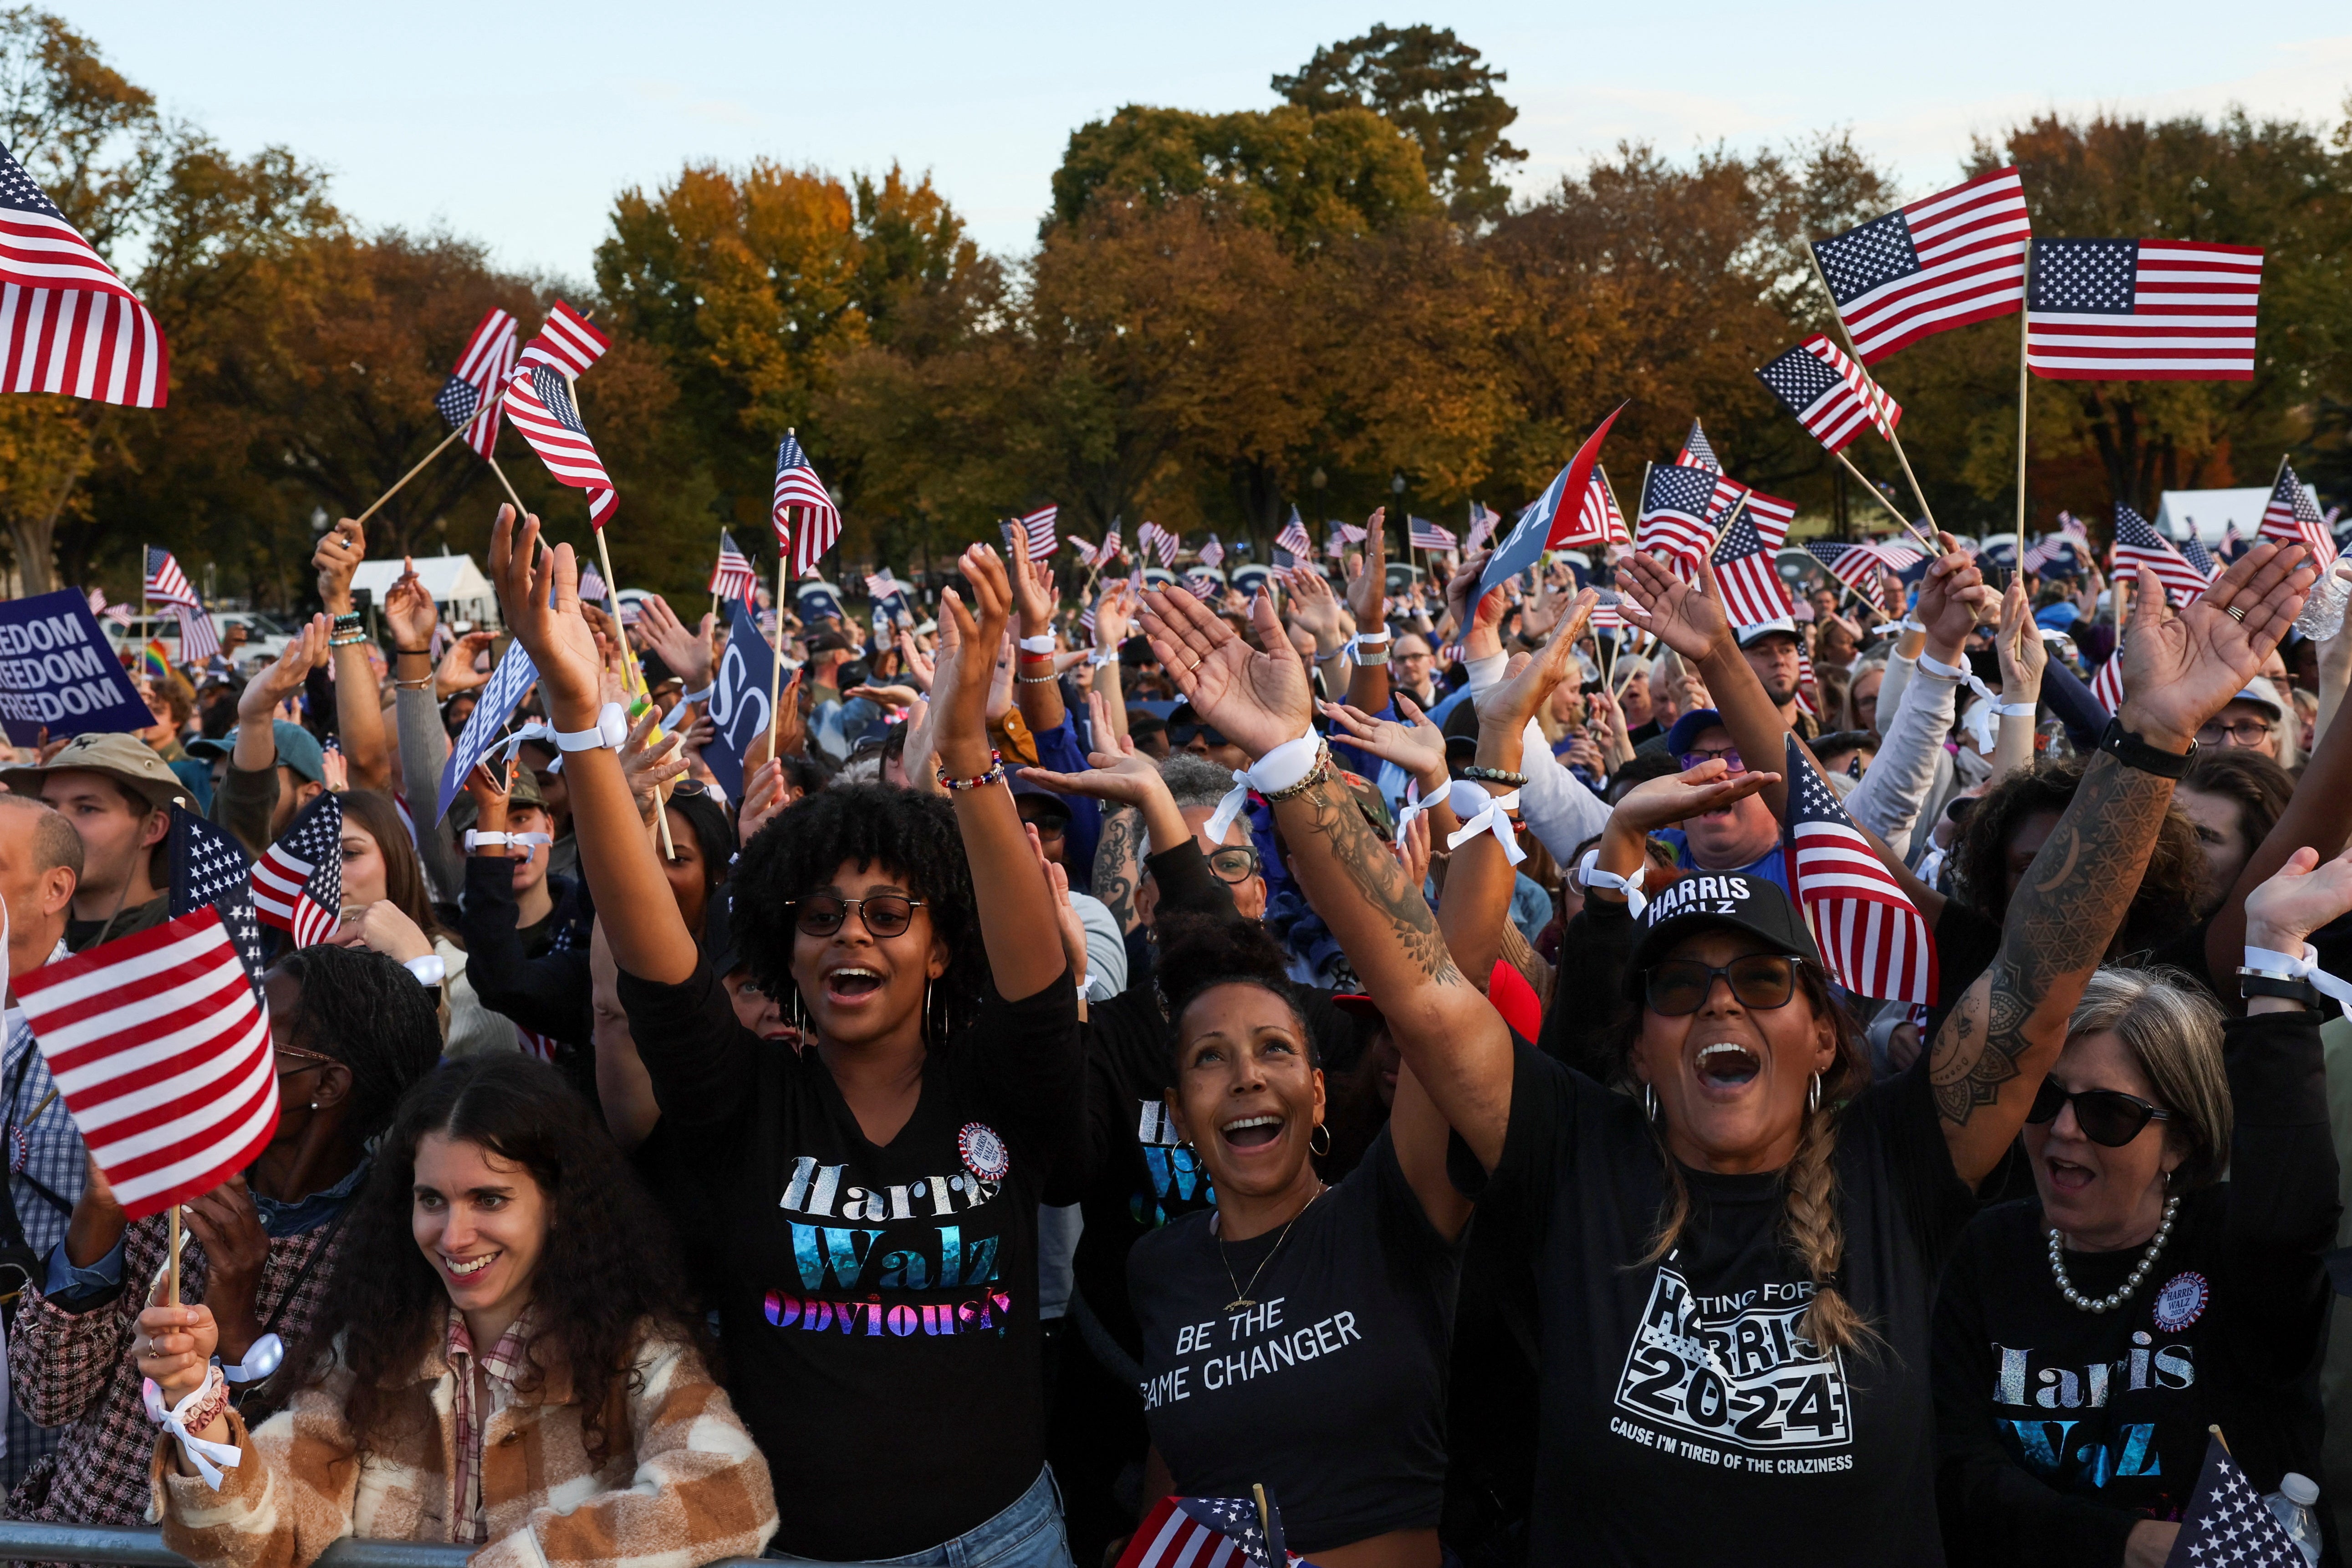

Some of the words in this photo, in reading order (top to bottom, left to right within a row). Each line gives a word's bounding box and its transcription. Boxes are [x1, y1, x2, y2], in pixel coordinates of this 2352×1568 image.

[0, 613, 88, 656] EDOM
[0, 677, 126, 723] FREEDOM
[709, 624, 770, 768] US
[1648, 876, 1750, 929] HARRIS
[973, 1134, 987, 1158] HARRIS
[982, 1141, 995, 1161] WALZ
[991, 1150, 999, 1164] 2024
[786, 1220, 999, 1290] Walz
[1764, 1281, 1817, 1301] FOR
[2167, 1287, 2194, 1302] HARRIS
[2168, 1298, 2190, 1310] WALZ
[2170, 1308, 2185, 1316] 2024
[1176, 1321, 1215, 1355] BE
[1229, 1297, 1285, 1341] THE
[1204, 1311, 1362, 1390] CHANGER
[1624, 1346, 1843, 1440] 2024
[1610, 1416, 1654, 1446] CAUSE
[1656, 1434, 1677, 1454] I'M
[1681, 1441, 1720, 1465] TIRED
[1724, 1453, 1741, 1470] OF
[1746, 1457, 1773, 1473] THE
[1777, 1455, 1853, 1474] CRAZINESS
